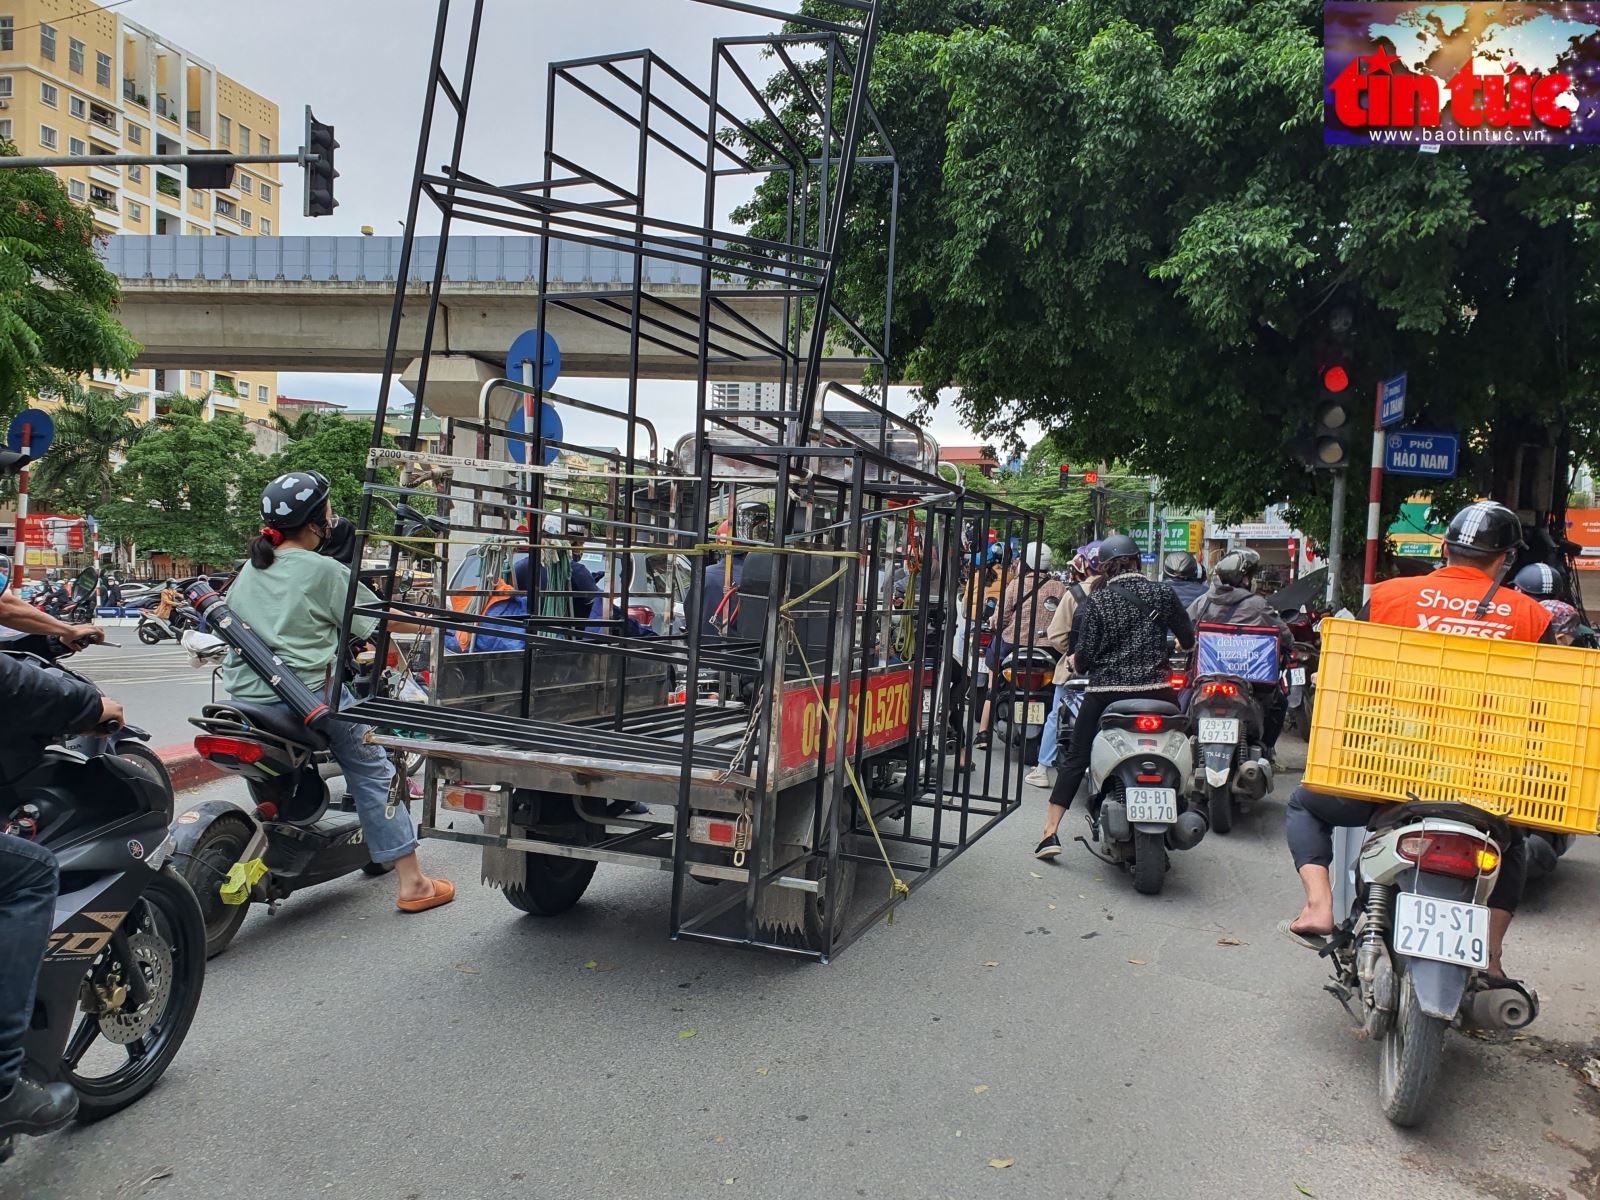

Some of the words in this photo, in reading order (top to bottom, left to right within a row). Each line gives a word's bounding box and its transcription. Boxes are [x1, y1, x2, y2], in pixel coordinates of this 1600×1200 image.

[1409, 436, 1433, 449] PHỐ
[380, 449, 402, 459] 2000
[1420, 454, 1449, 470] NAM
[1128, 528, 1149, 539] HOA
[1171, 528, 1184, 538] TP
[1416, 588, 1512, 618] Shopee
[1217, 637, 1256, 648] delivery
[1216, 649, 1259, 660] pizza4ps
[1226, 662, 1249, 671] .com
[1205, 720, 1232, 730] 29-X7
[1134, 790, 1167, 804] 29-B1
[1130, 806, 1173, 820] 891.70
[1414, 900, 1474, 933] 19-S1
[1400, 925, 1483, 963] 271.49
